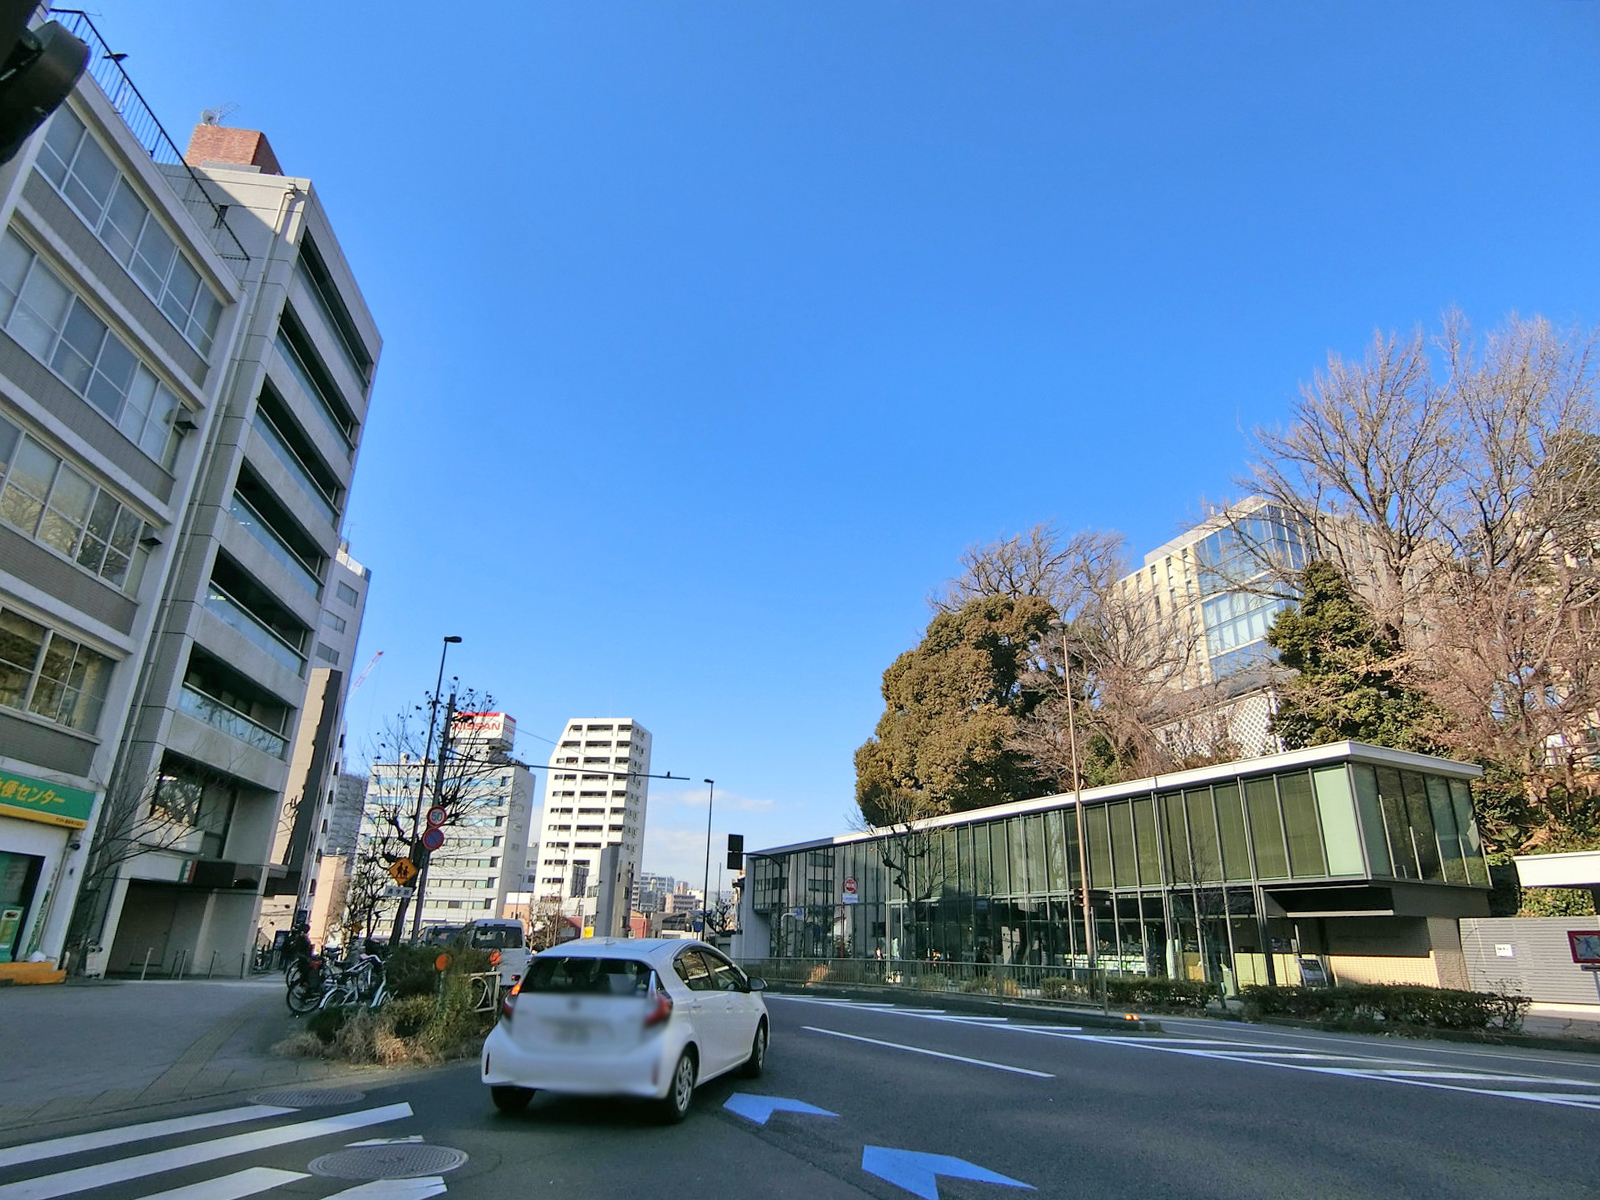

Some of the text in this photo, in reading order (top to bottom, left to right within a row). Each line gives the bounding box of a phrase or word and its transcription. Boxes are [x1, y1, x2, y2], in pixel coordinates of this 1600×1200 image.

[0, 777, 66, 805] 便センター
[431, 811, 443, 821] 50
